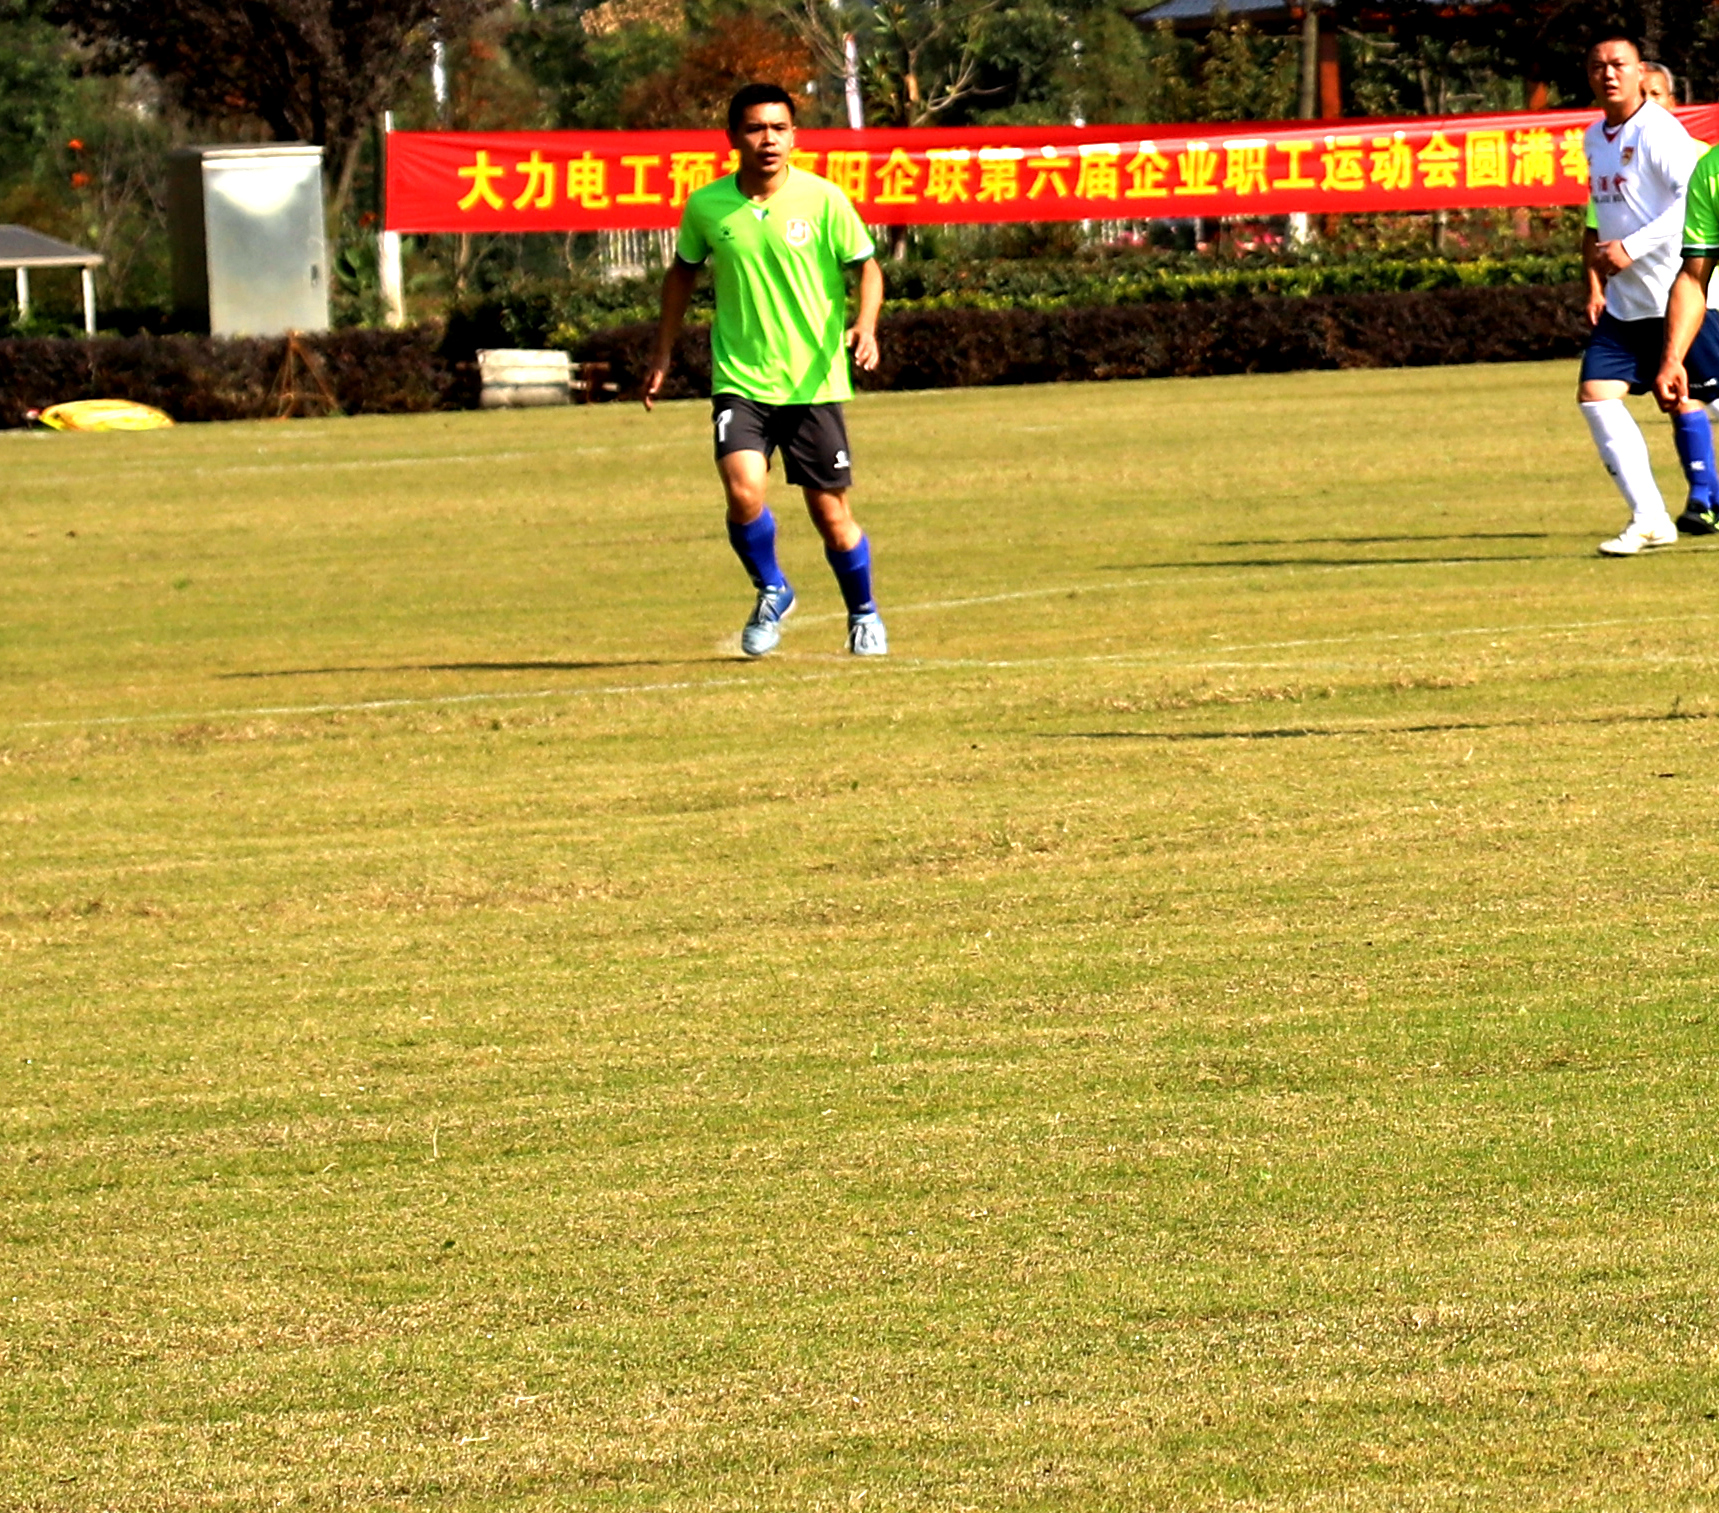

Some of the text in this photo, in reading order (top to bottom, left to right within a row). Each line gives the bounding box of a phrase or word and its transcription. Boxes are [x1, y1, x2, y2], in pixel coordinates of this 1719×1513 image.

[456, 128, 1588, 210] 大力电工预阳企联第六届企业职工运动会圆满举
